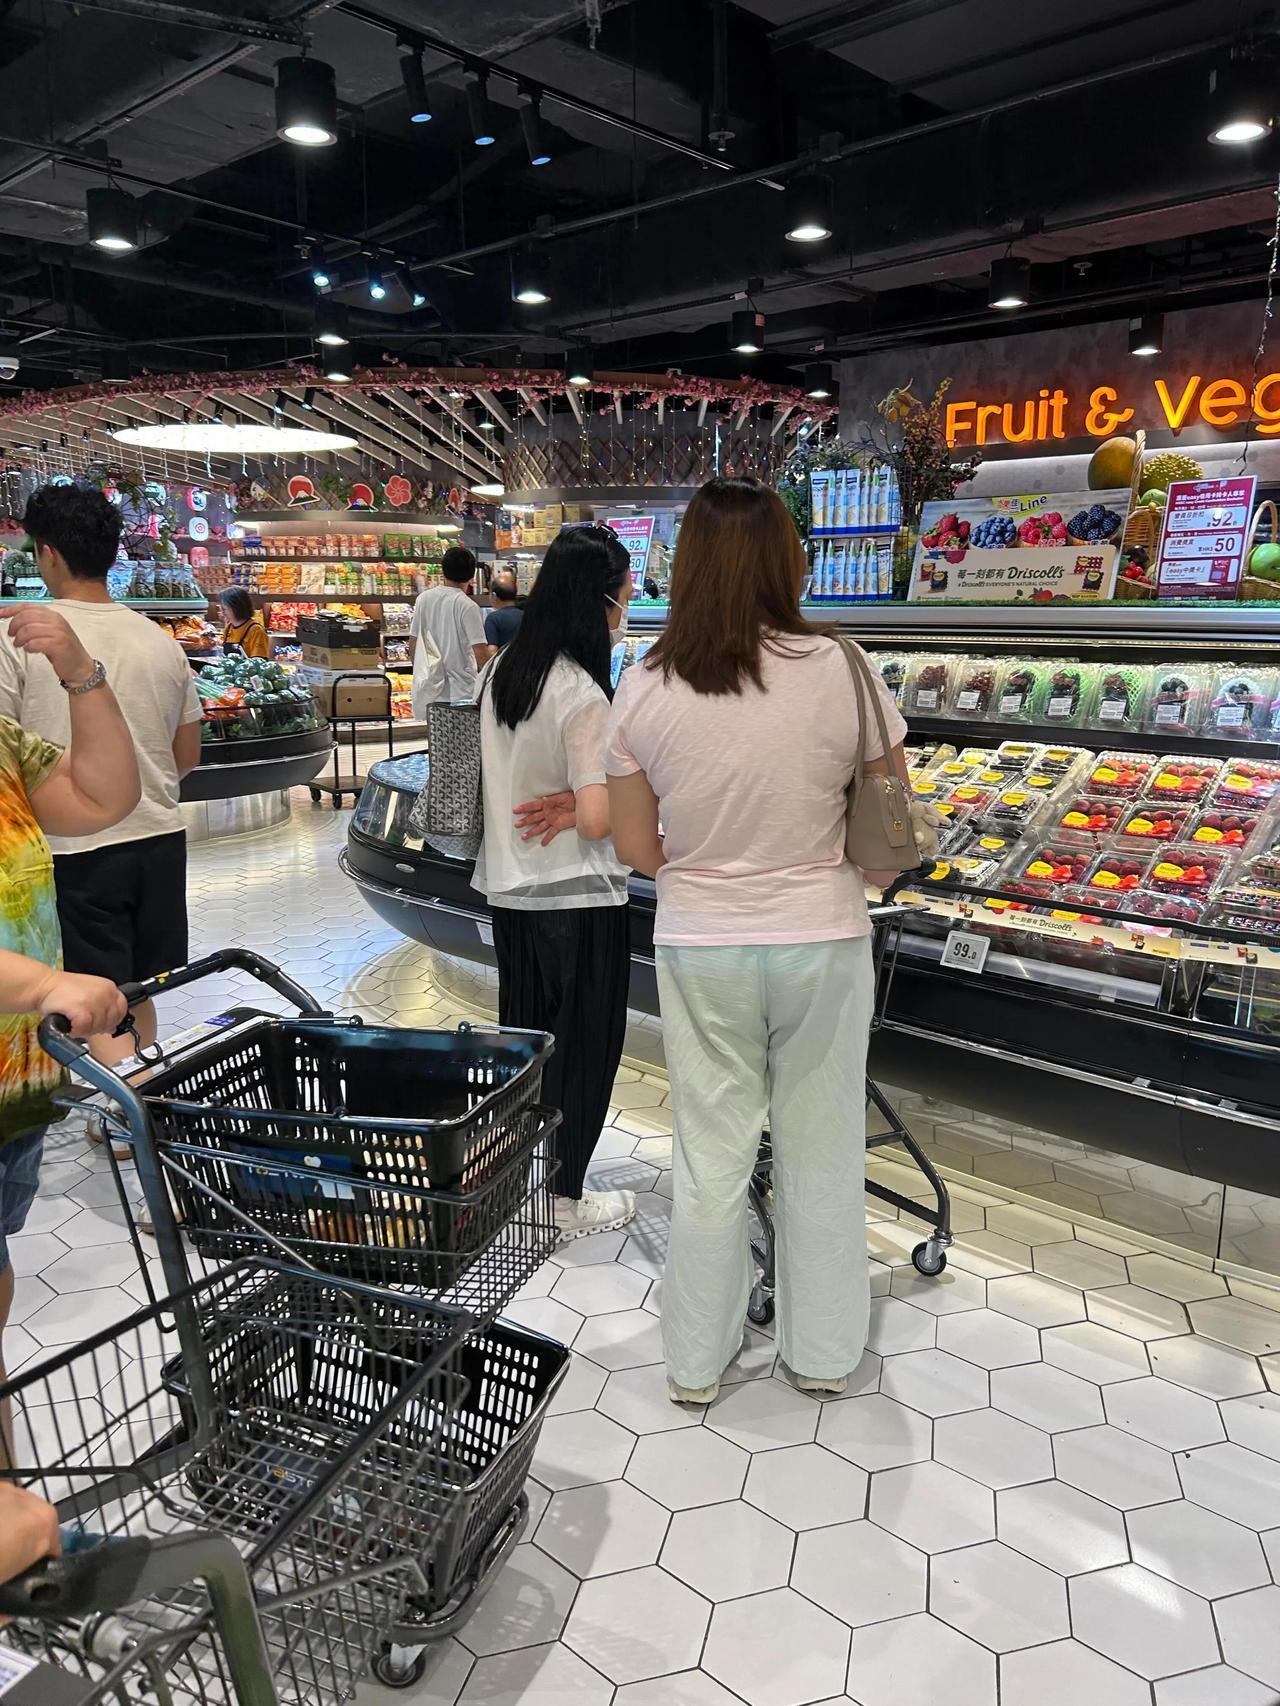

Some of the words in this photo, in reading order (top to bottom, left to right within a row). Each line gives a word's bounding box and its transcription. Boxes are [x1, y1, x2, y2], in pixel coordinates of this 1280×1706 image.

[945, 389, 1069, 448] Fruit
[1085, 386, 1135, 437] &
[1019, 495, 1047, 512] Line
[629, 540, 641, 551] 92
[1214, 537, 1236, 552] 50
